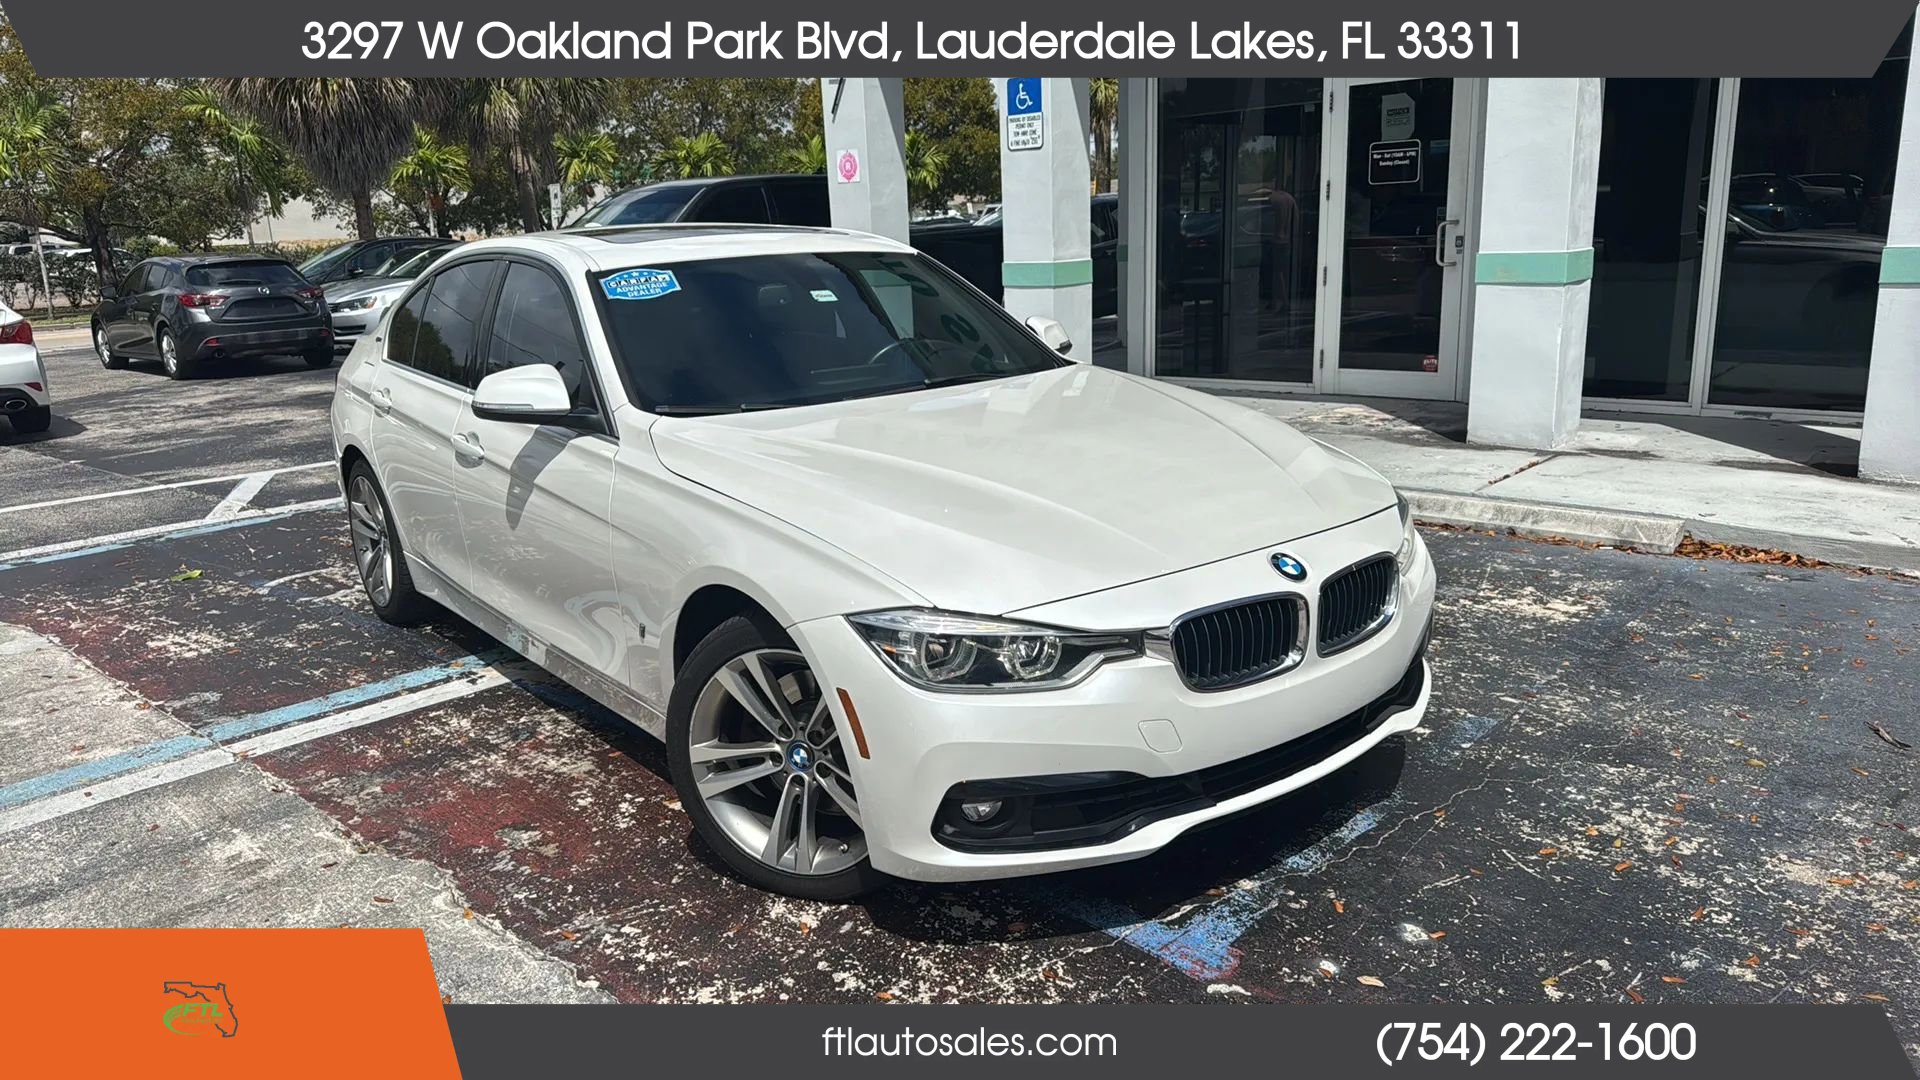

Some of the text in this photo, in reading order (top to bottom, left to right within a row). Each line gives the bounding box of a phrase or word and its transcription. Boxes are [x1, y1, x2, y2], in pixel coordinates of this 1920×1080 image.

[608, 275, 670, 288] CARFAX
[616, 282, 668, 293] ADVANTAGE
[627, 289, 662, 297] DEALER
